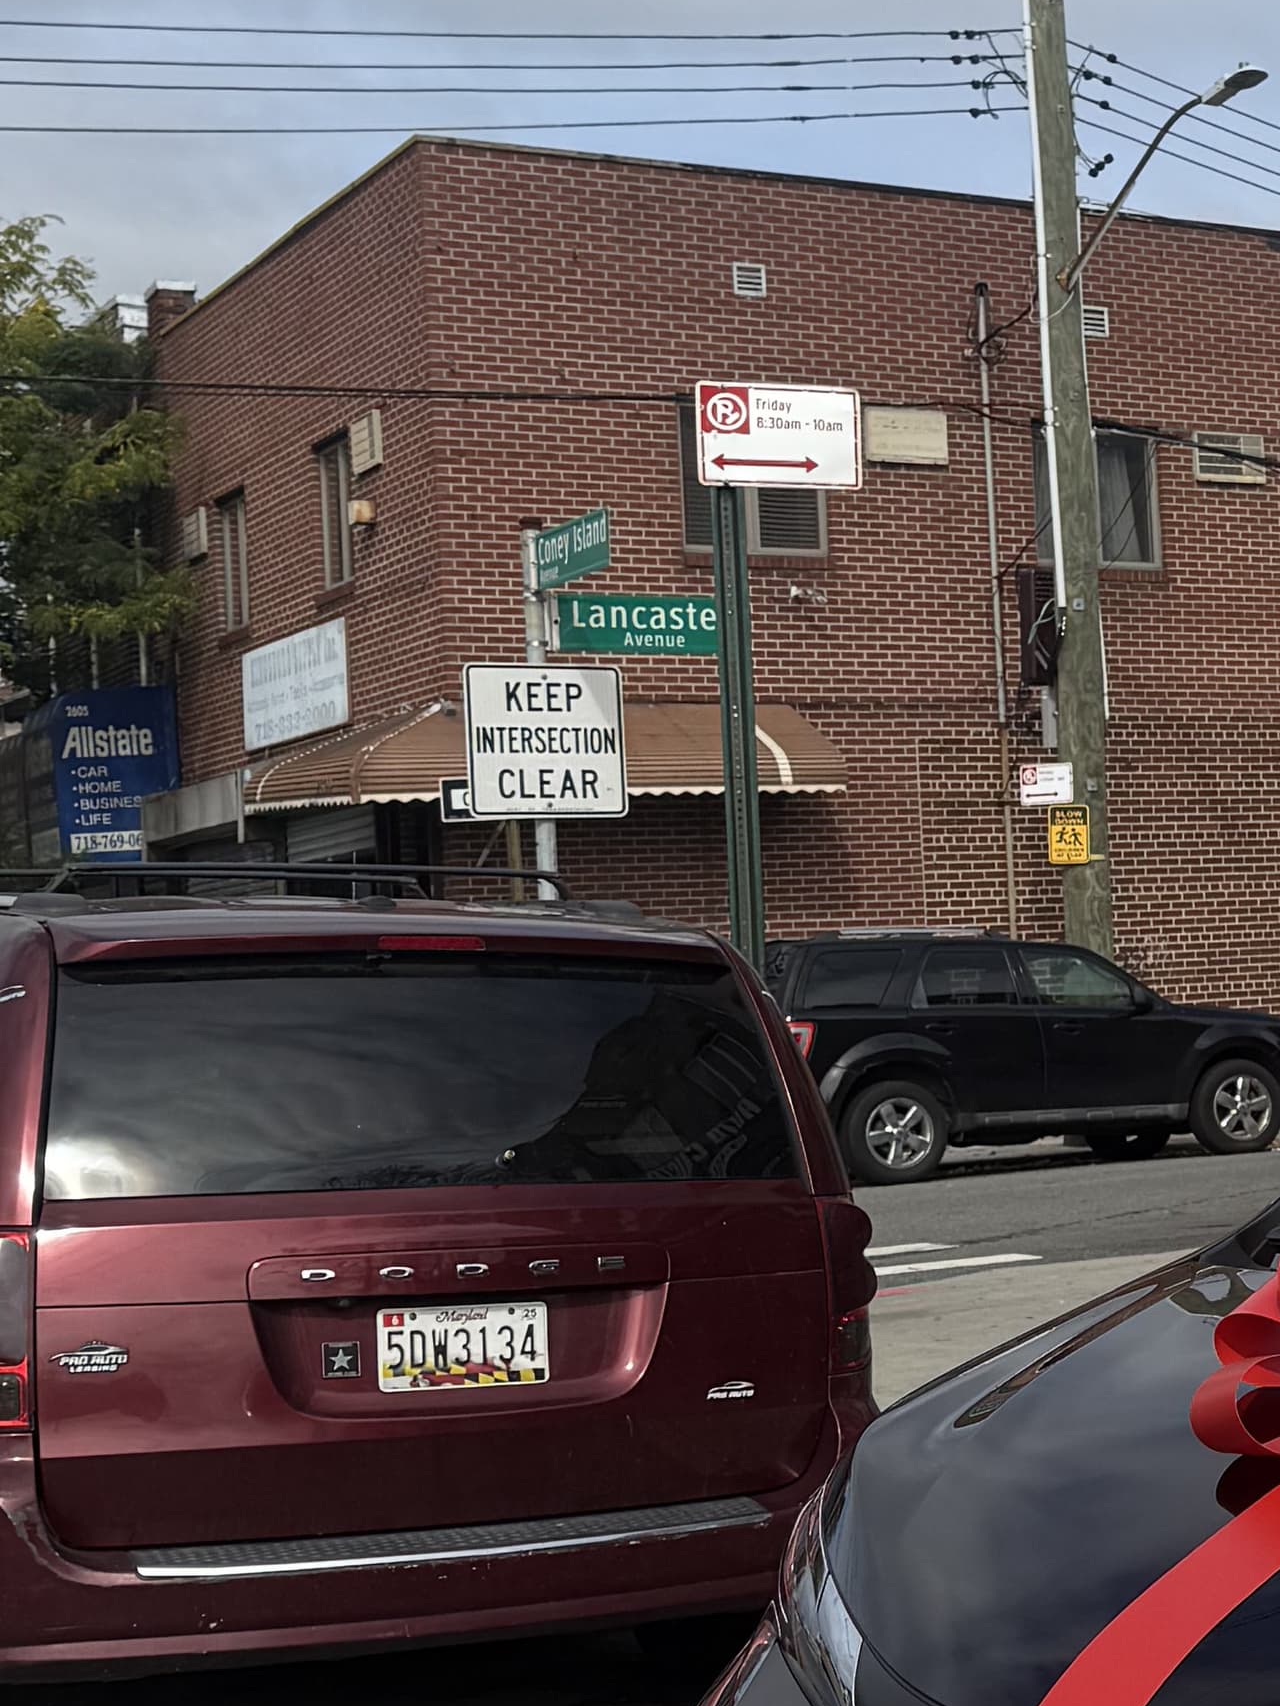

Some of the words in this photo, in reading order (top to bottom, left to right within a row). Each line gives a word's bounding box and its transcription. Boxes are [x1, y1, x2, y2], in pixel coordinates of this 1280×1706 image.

[756, 398, 792, 413] Friday
[813, 418, 843, 431] 10am
[538, 535, 569, 565] Coney
[573, 510, 606, 553] Island
[572, 601, 717, 630] Lancaste
[623, 632, 686, 648] Avenue
[505, 681, 583, 712] KEEP
[62, 724, 153, 759] Allstate
[476, 726, 616, 754] INTERSECTION
[77, 765, 108, 778] CAR
[78, 780, 121, 794] HOME
[498, 768, 599, 799] CLEAR
[79, 796, 142, 811] BUSINES
[81, 813, 112, 826] LIFE
[301, 1255, 626, 1281] DODGE
[387, 1324, 537, 1370] 5DW3134
[90, 1354, 128, 1364] AUTO
